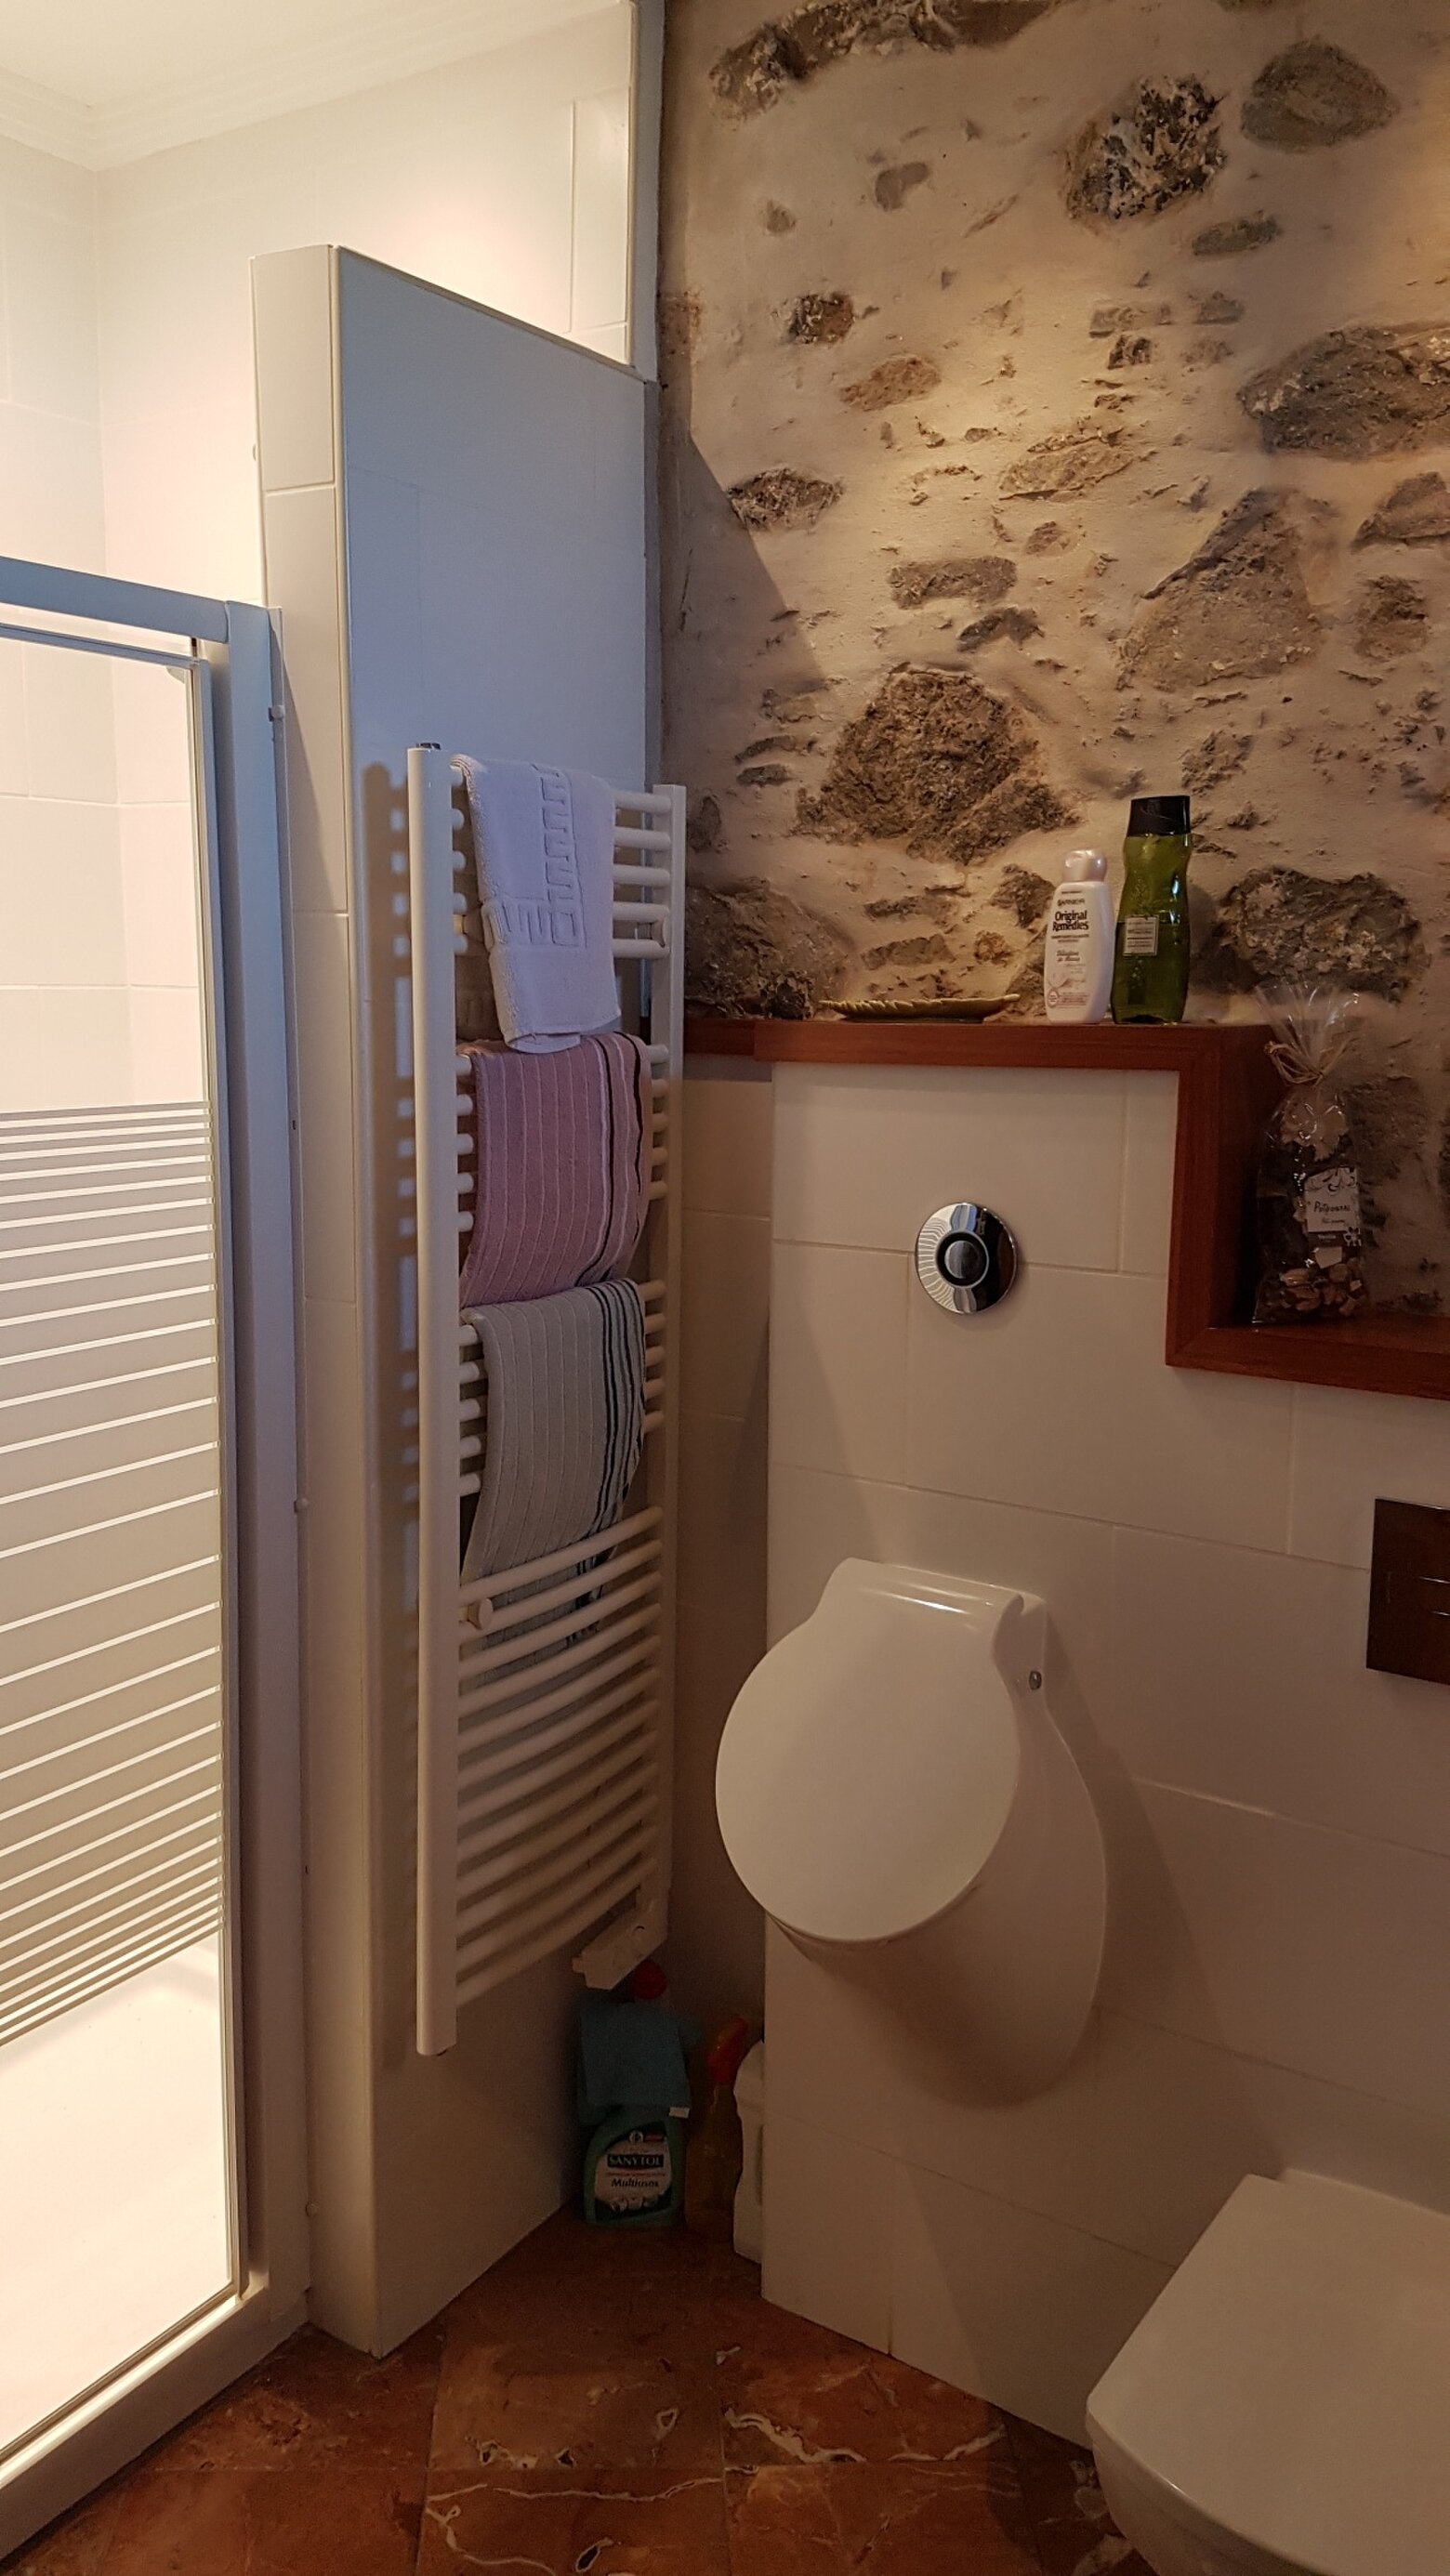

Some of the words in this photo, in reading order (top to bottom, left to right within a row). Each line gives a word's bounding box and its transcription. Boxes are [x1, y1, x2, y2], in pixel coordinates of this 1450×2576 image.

[1055, 910, 1088, 924] Original
[1052, 919, 1089, 932] Remedies
[609, 2156, 661, 2166] SANYTOL
